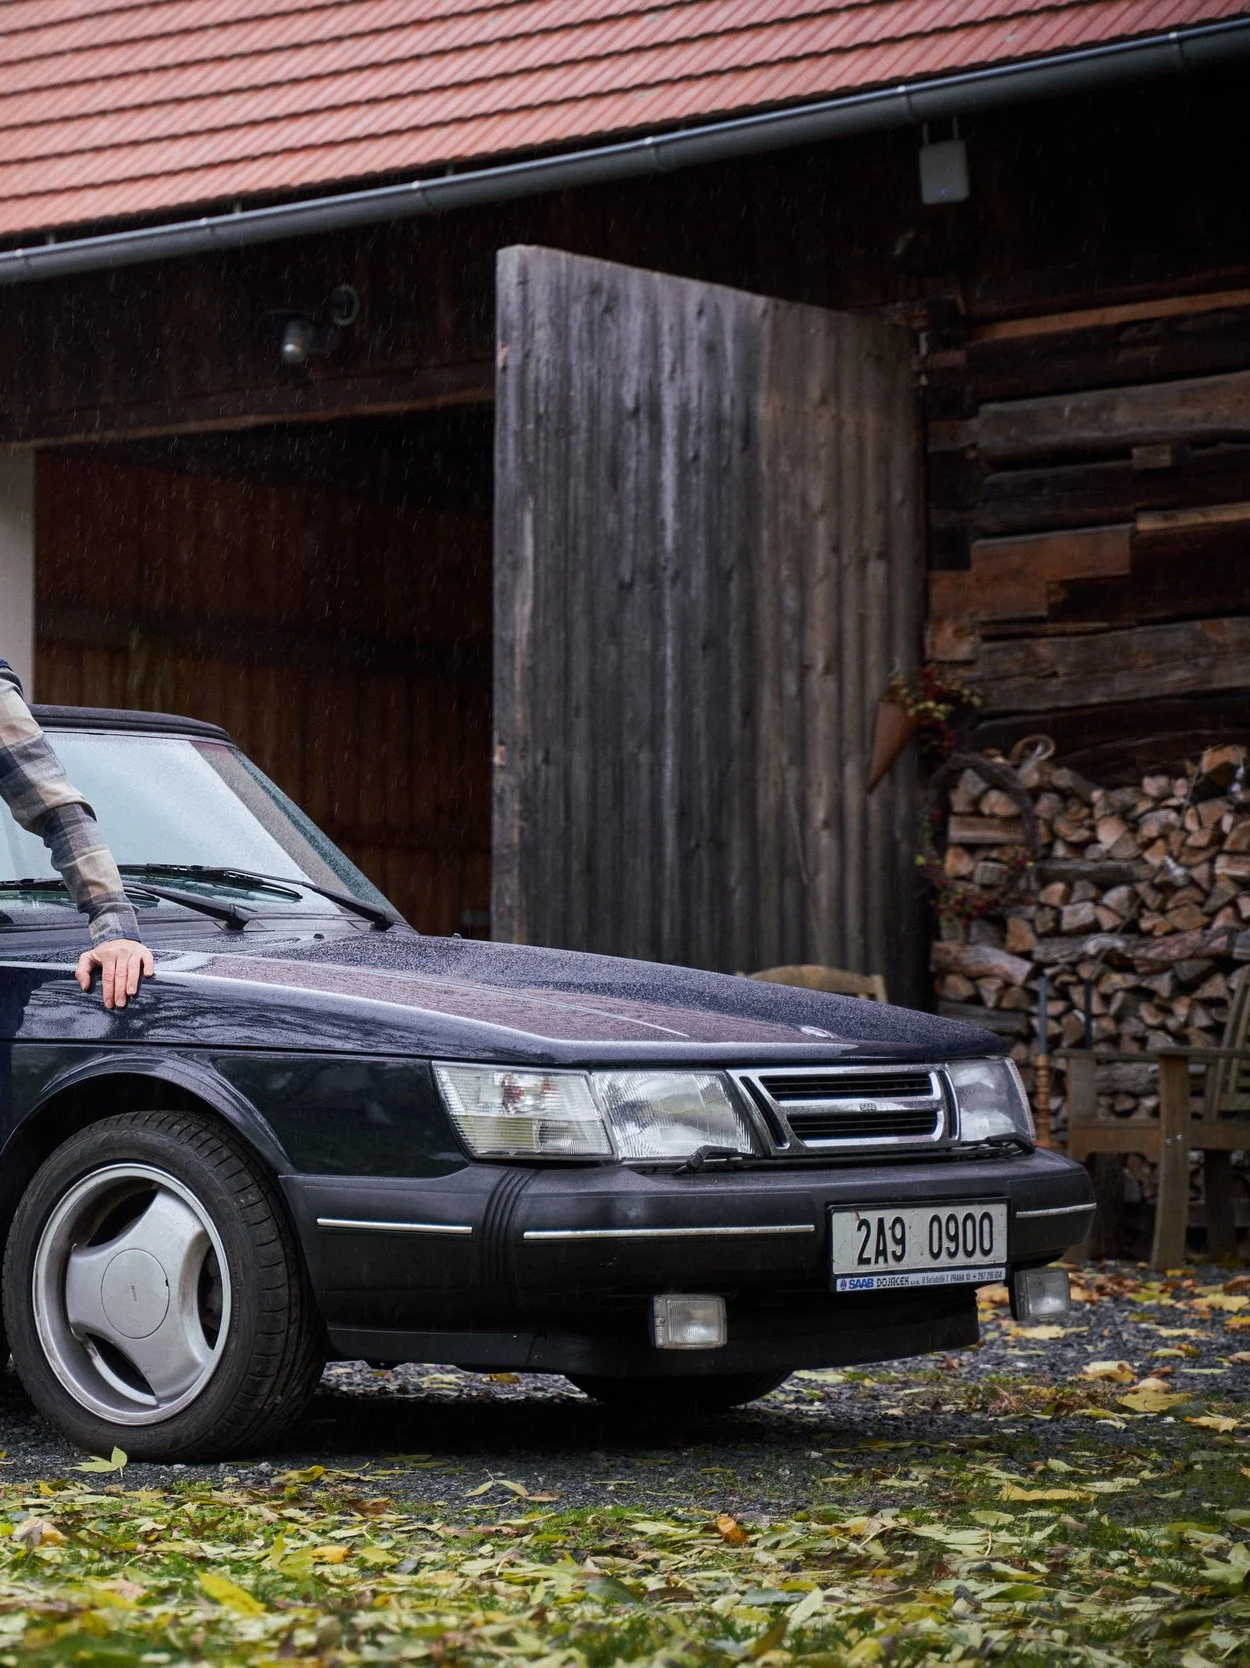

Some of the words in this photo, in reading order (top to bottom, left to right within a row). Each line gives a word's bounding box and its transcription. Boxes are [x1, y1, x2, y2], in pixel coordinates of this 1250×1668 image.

[857, 1216, 906, 1266] 2A9
[929, 1211, 994, 1261] 0900
[848, 1277, 874, 1290] SAAB
